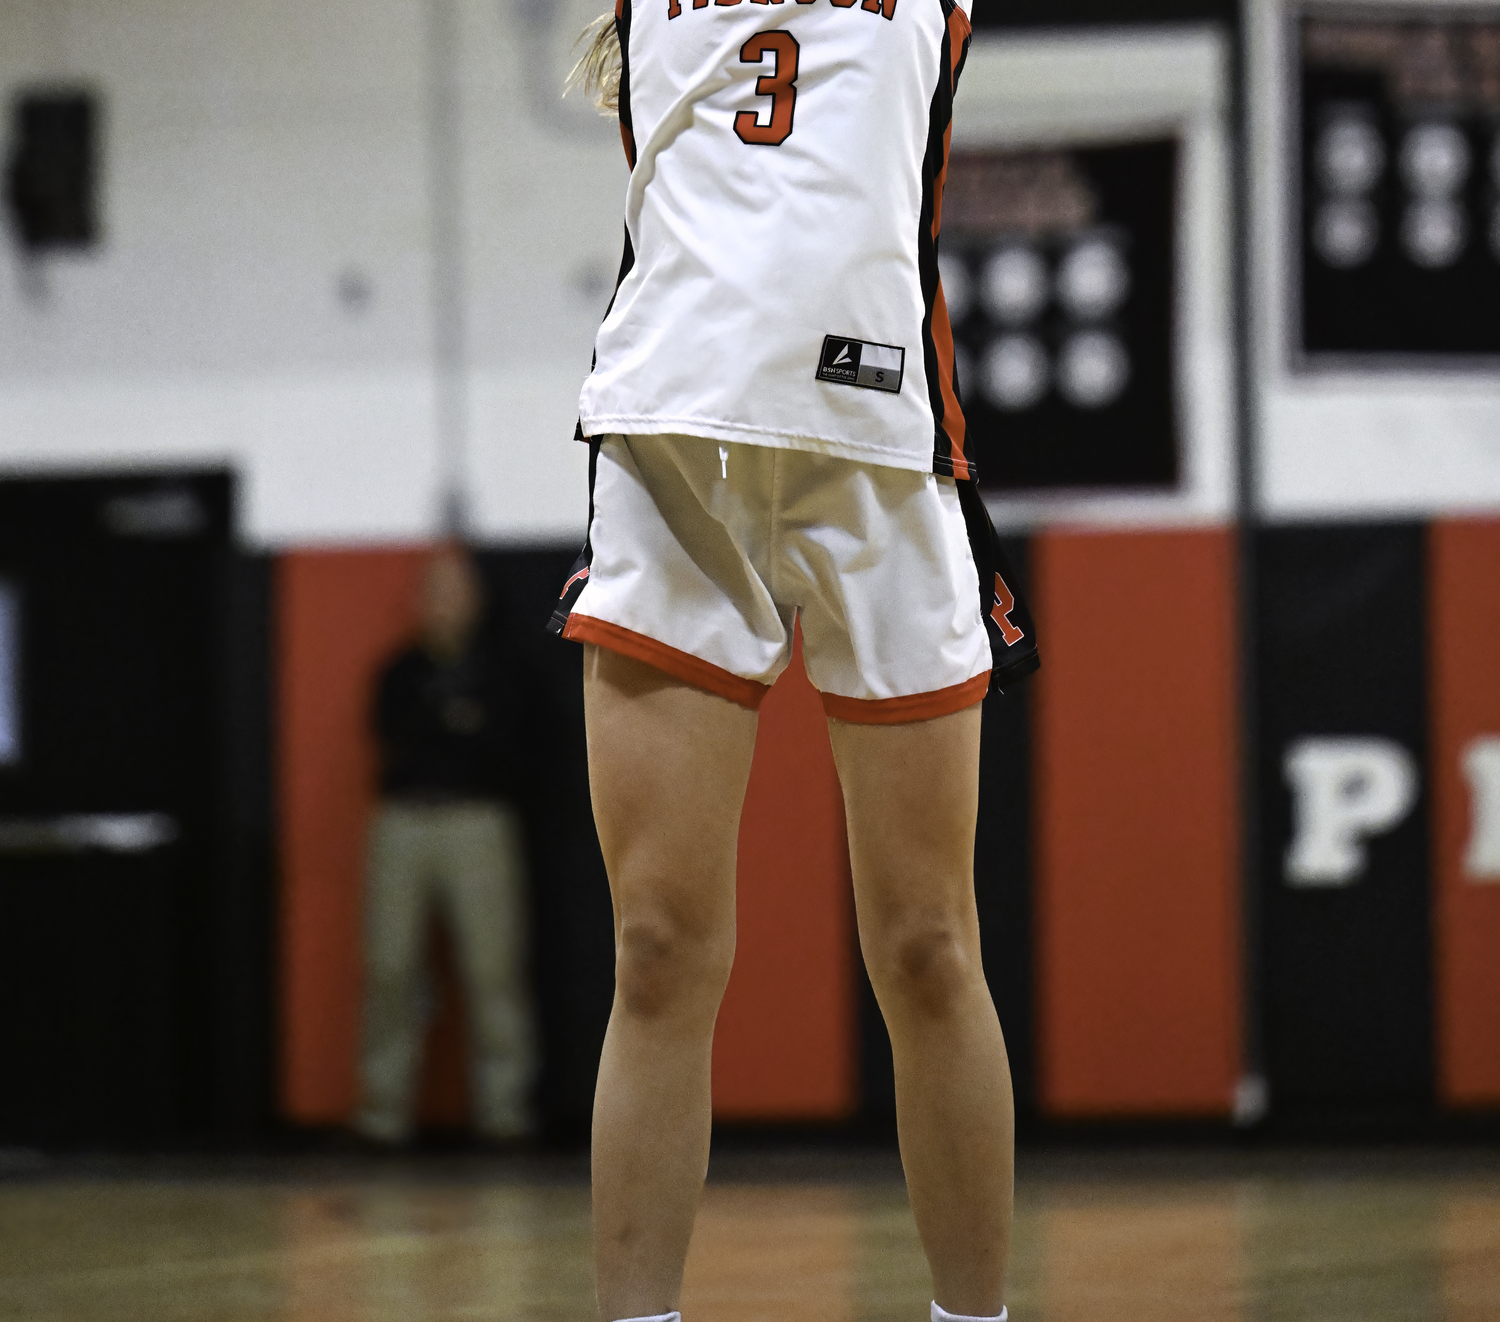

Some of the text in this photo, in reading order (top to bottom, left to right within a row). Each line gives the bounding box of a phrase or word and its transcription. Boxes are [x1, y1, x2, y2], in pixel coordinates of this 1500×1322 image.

[733, 29, 800, 146] 3
[836, 368, 856, 377] SPORTS
[875, 371, 885, 383] S
